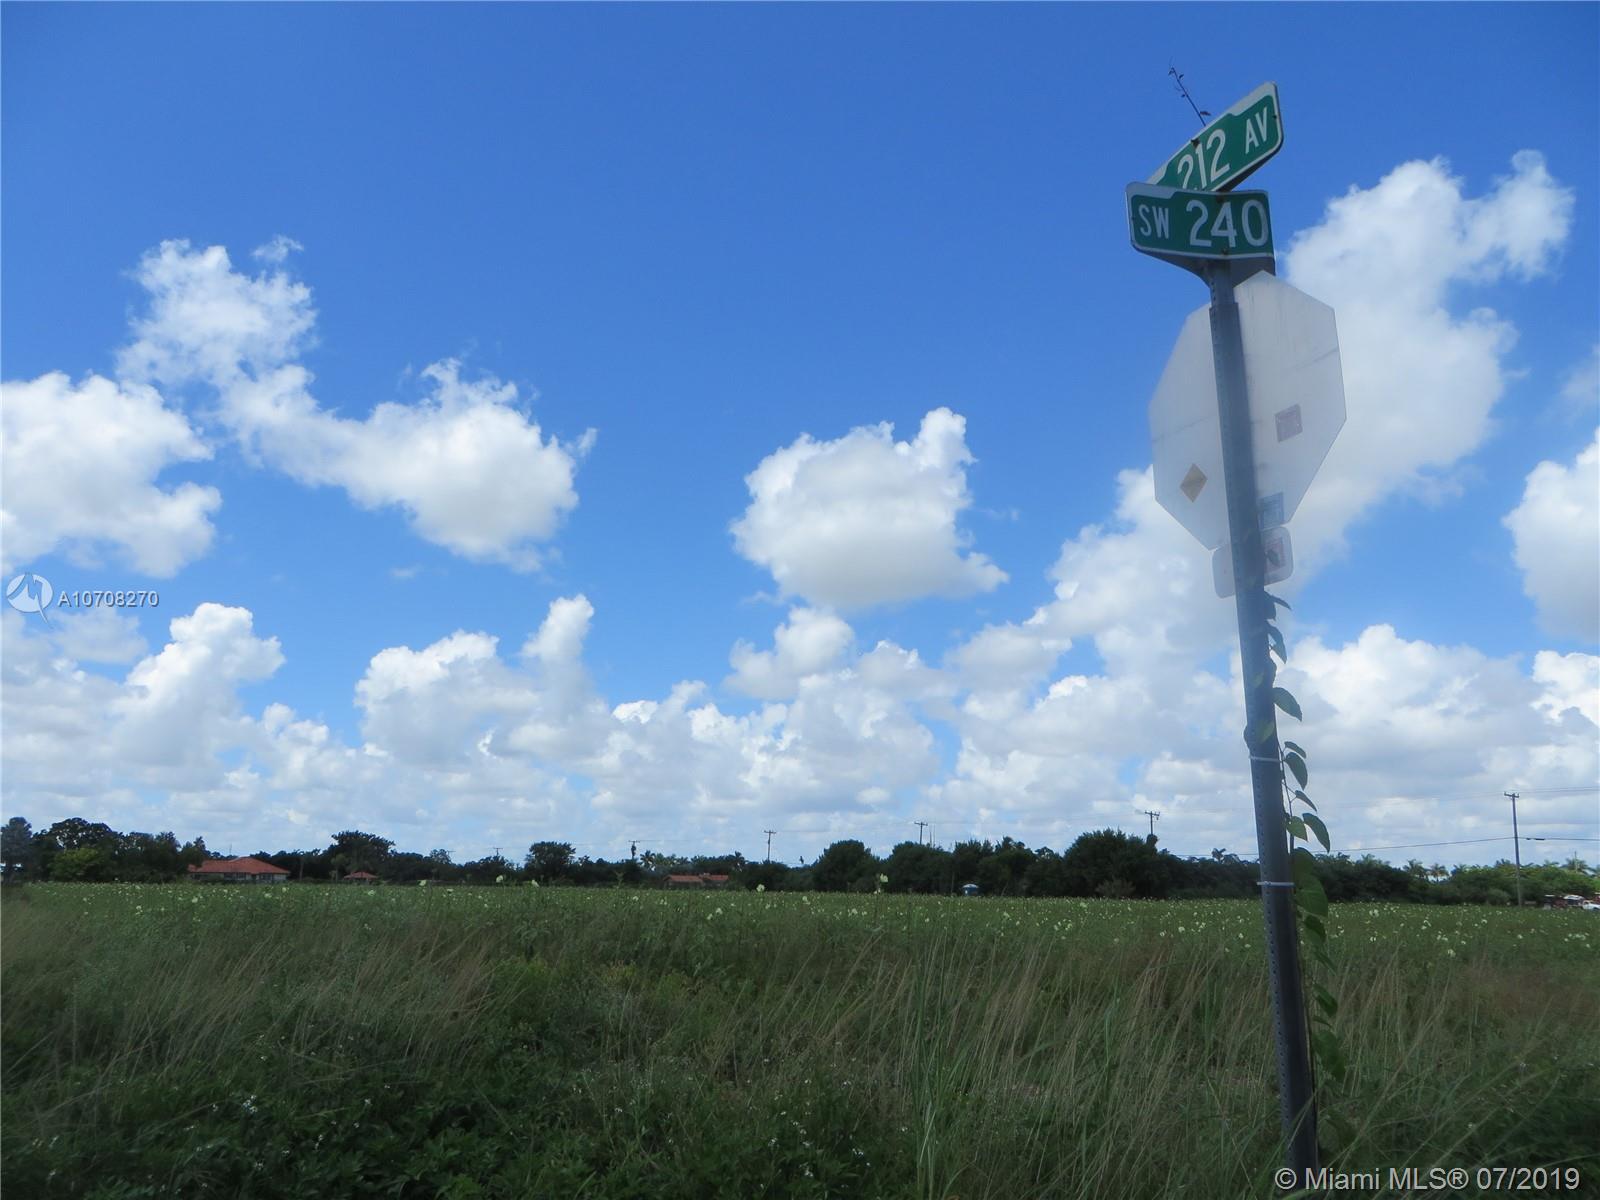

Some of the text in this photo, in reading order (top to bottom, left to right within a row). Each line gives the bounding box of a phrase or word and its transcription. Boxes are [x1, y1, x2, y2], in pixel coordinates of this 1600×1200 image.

[1176, 107, 1268, 190] 212 AV
[1138, 199, 1269, 248] SW 240
